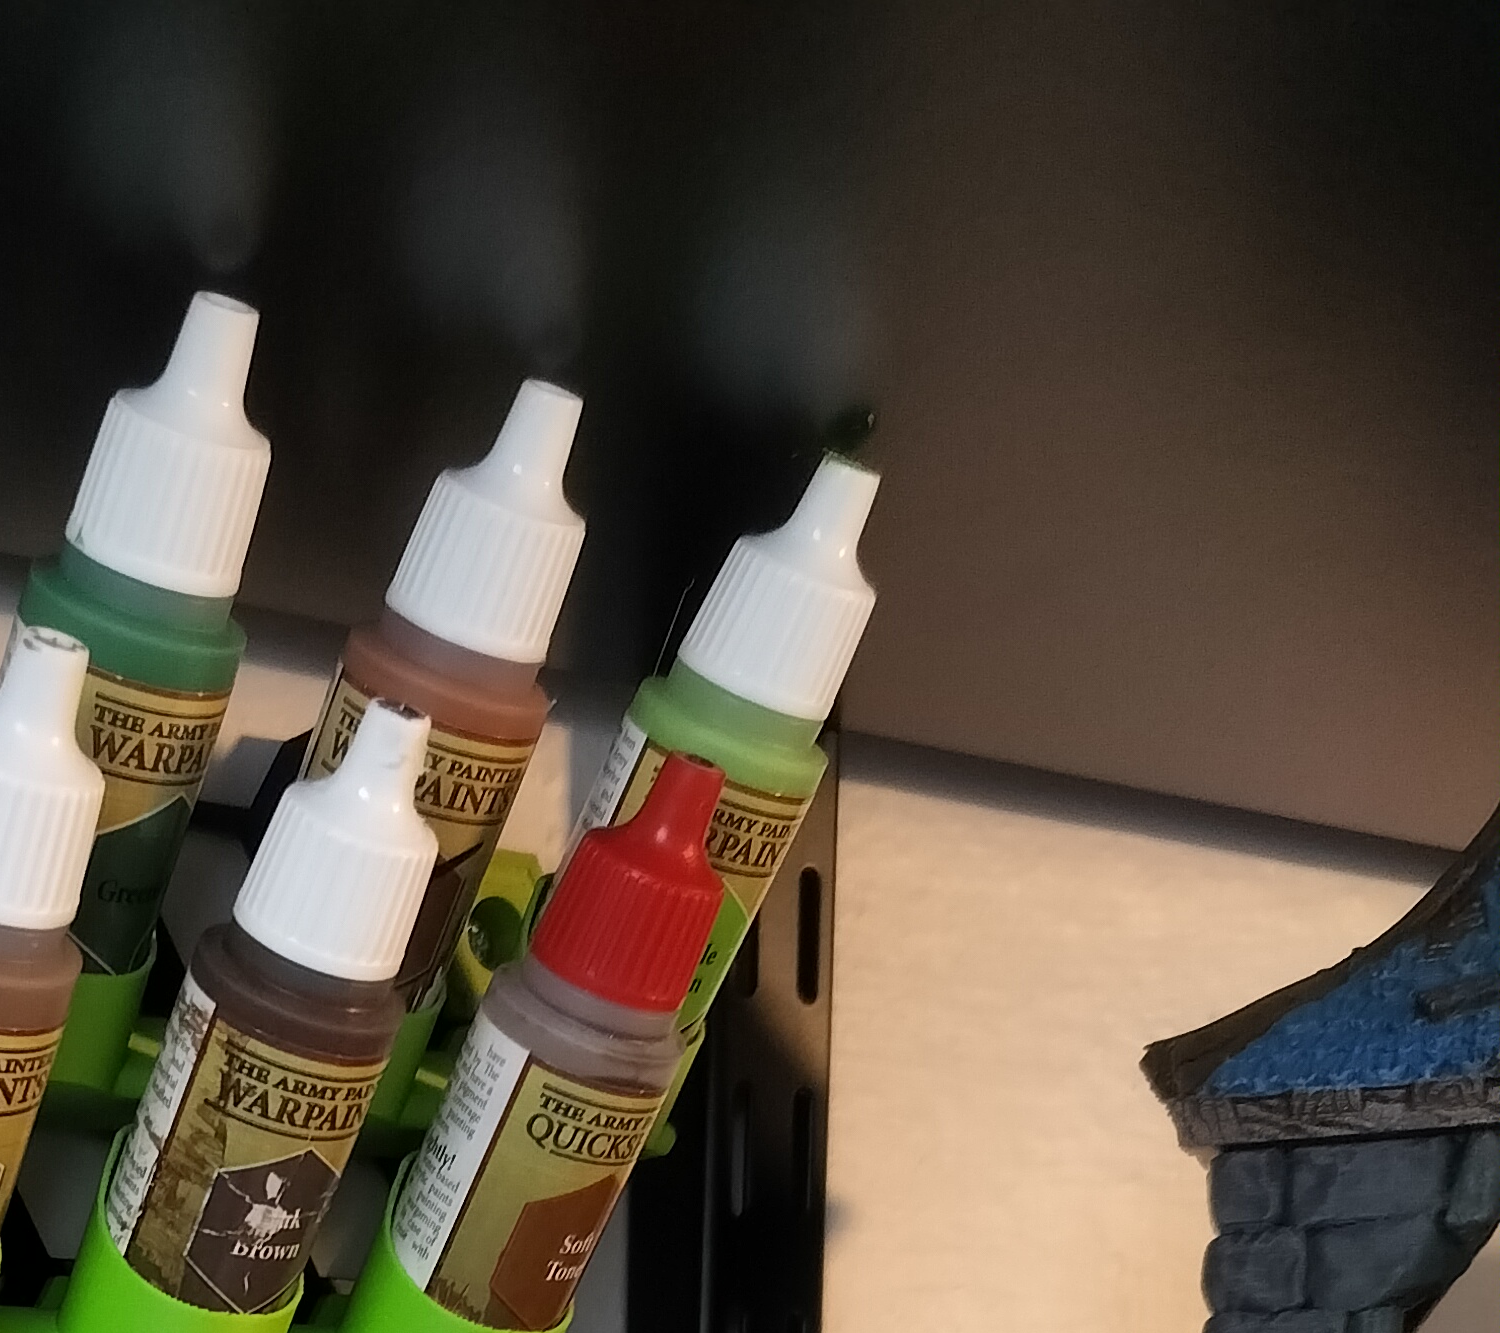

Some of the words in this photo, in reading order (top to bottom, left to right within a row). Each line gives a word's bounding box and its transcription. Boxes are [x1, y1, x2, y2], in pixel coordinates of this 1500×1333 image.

[93, 703, 146, 733] THE
[148, 721, 209, 741] ARMY
[711, 807, 760, 834] RMY
[223, 1049, 270, 1085] THE
[272, 1075, 344, 1102] ARMY
[539, 1092, 586, 1122] THE
[587, 1112, 644, 1131] ARMY
